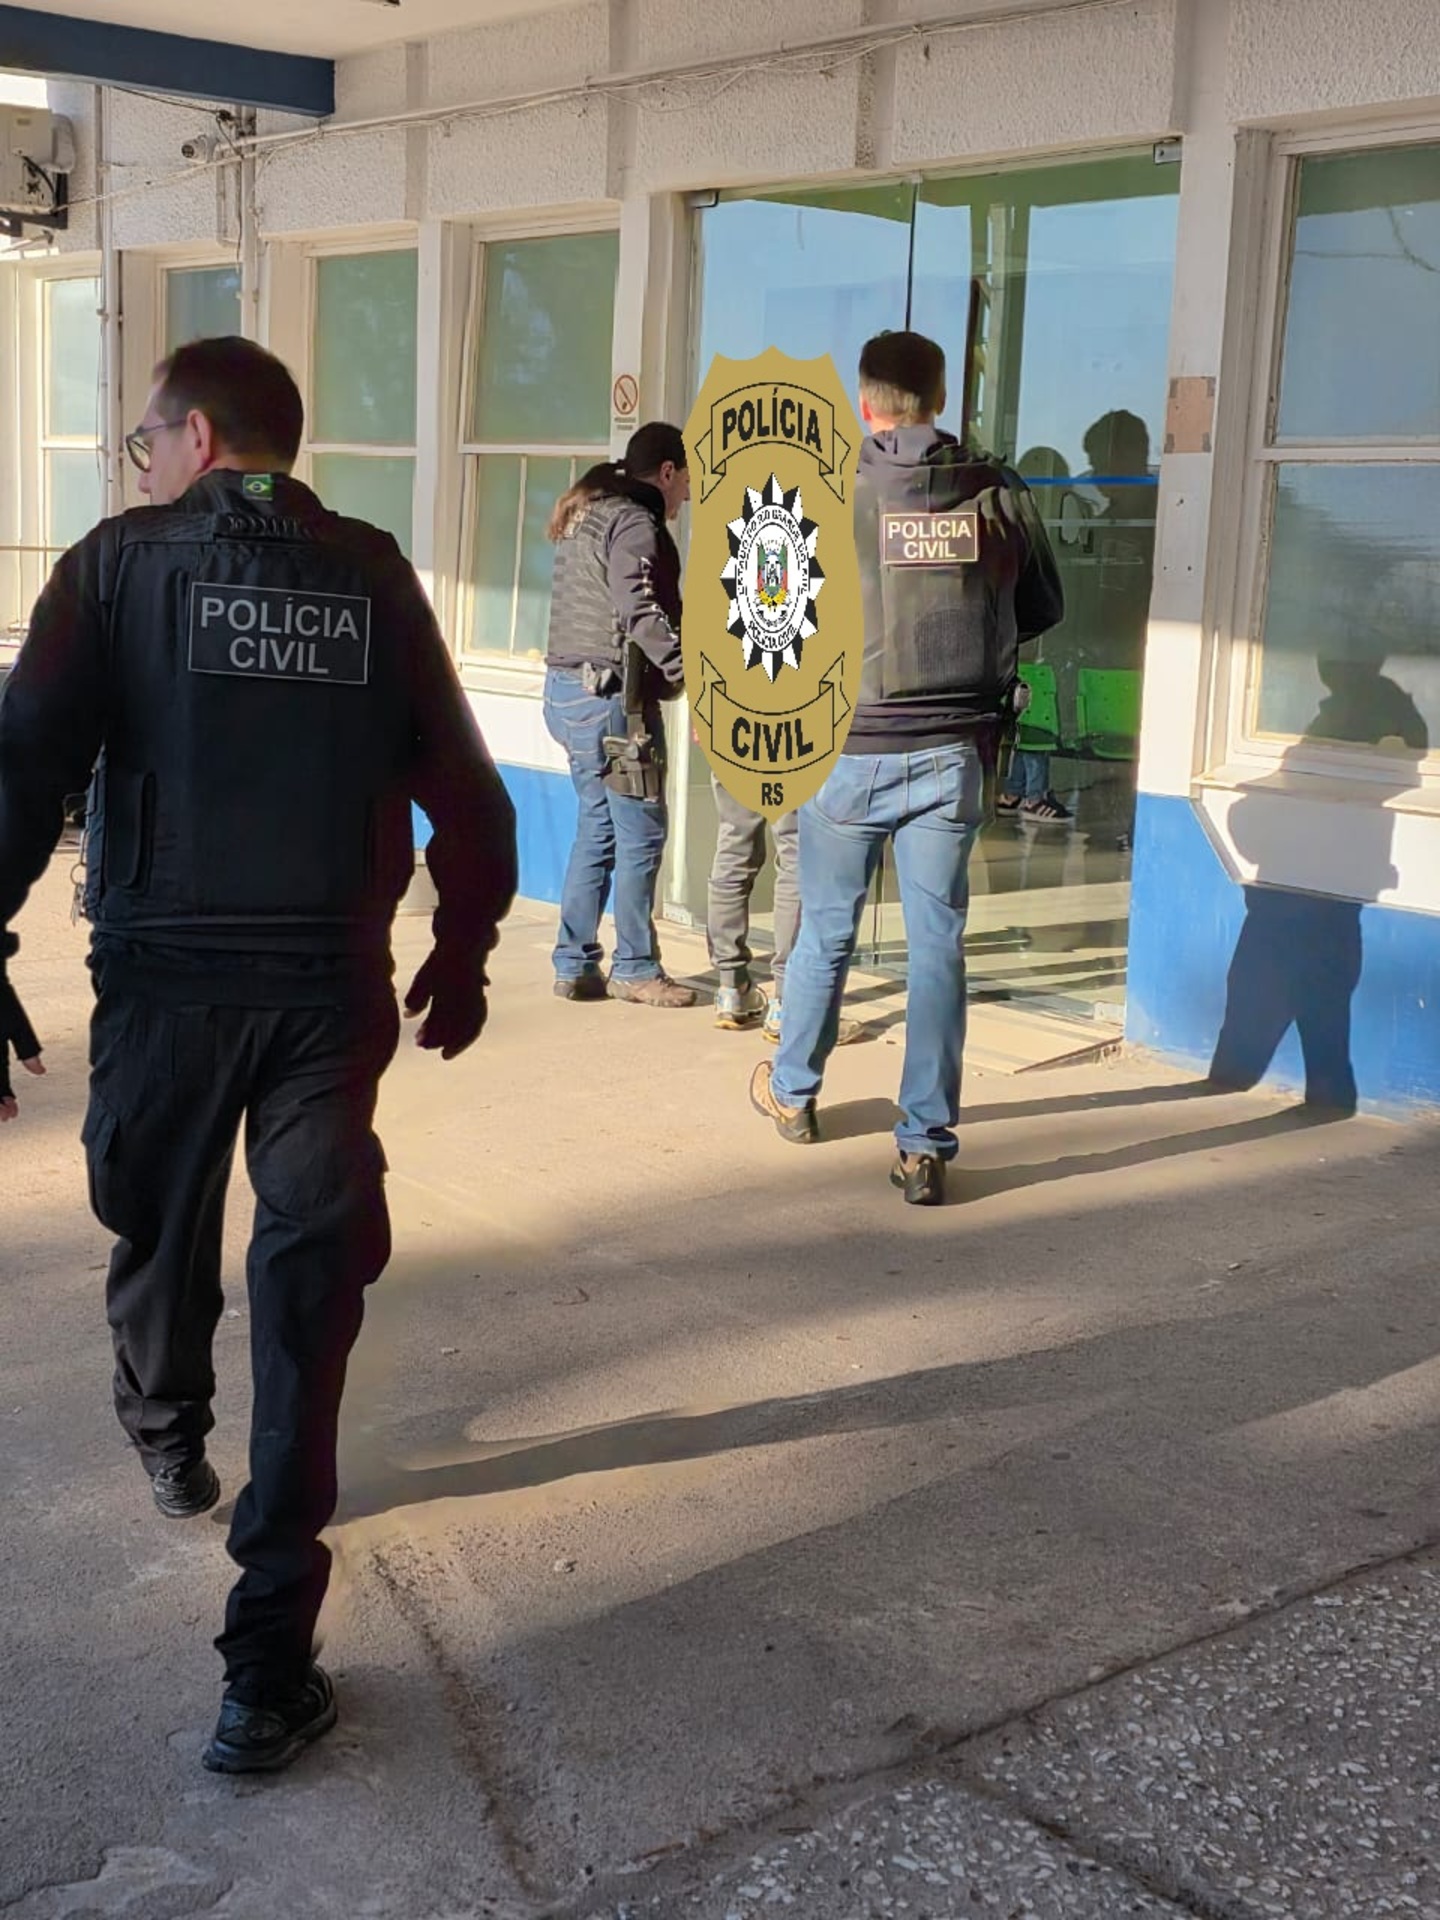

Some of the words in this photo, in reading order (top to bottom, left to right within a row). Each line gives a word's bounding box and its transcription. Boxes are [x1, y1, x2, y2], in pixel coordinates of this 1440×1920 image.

[888, 517, 972, 539] POLÍCIA
[903, 541, 957, 559] CIVIL
[201, 597, 359, 640] POLÍCIA
[229, 636, 329, 674] CIVIL
